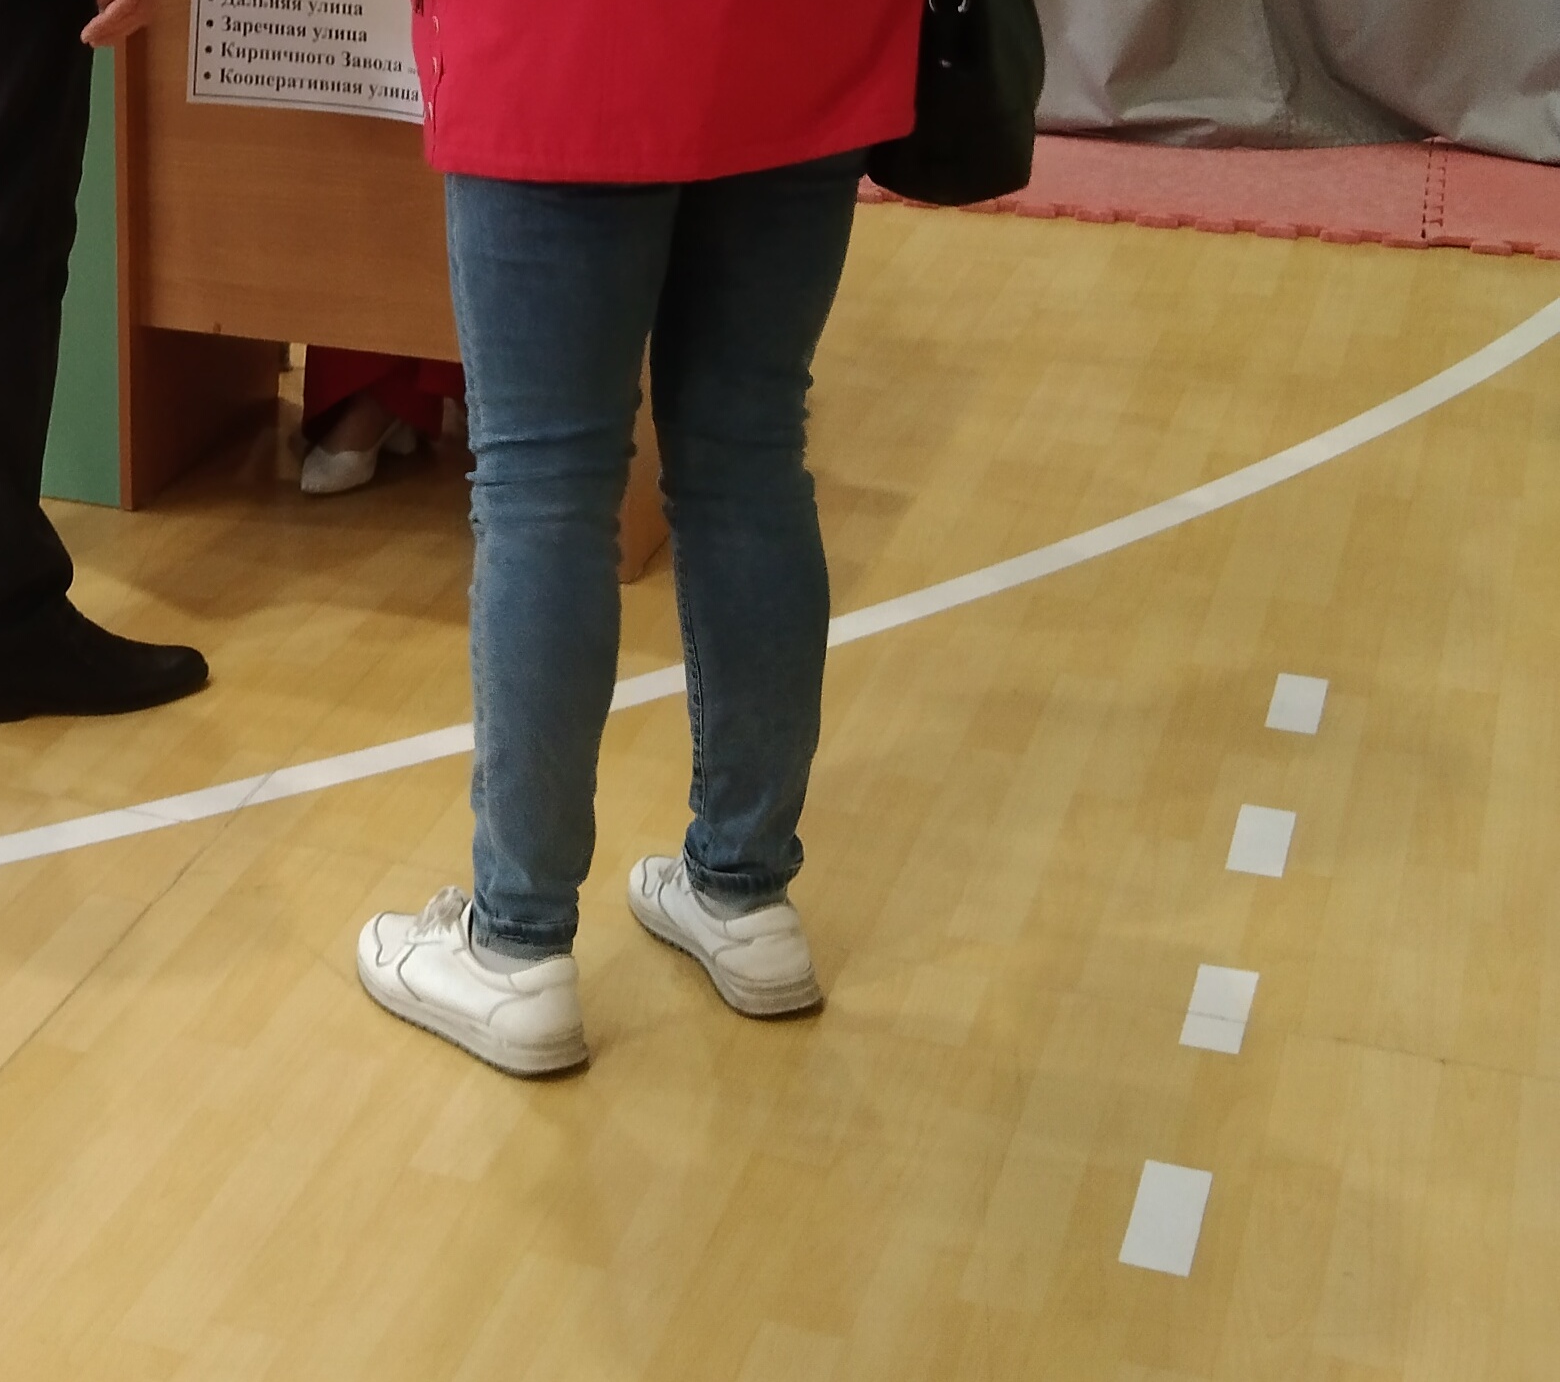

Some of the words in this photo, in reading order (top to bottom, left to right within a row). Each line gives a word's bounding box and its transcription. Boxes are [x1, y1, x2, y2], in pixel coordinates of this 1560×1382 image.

[308, 0, 363, 17] улица
[221, 15, 306, 38] Заречная
[312, 26, 367, 43] улица
[220, 42, 336, 66] Кирпичного
[341, 50, 402, 72] Завода
[220, 67, 362, 95] Кооперативная
[368, 83, 419, 102] улица
